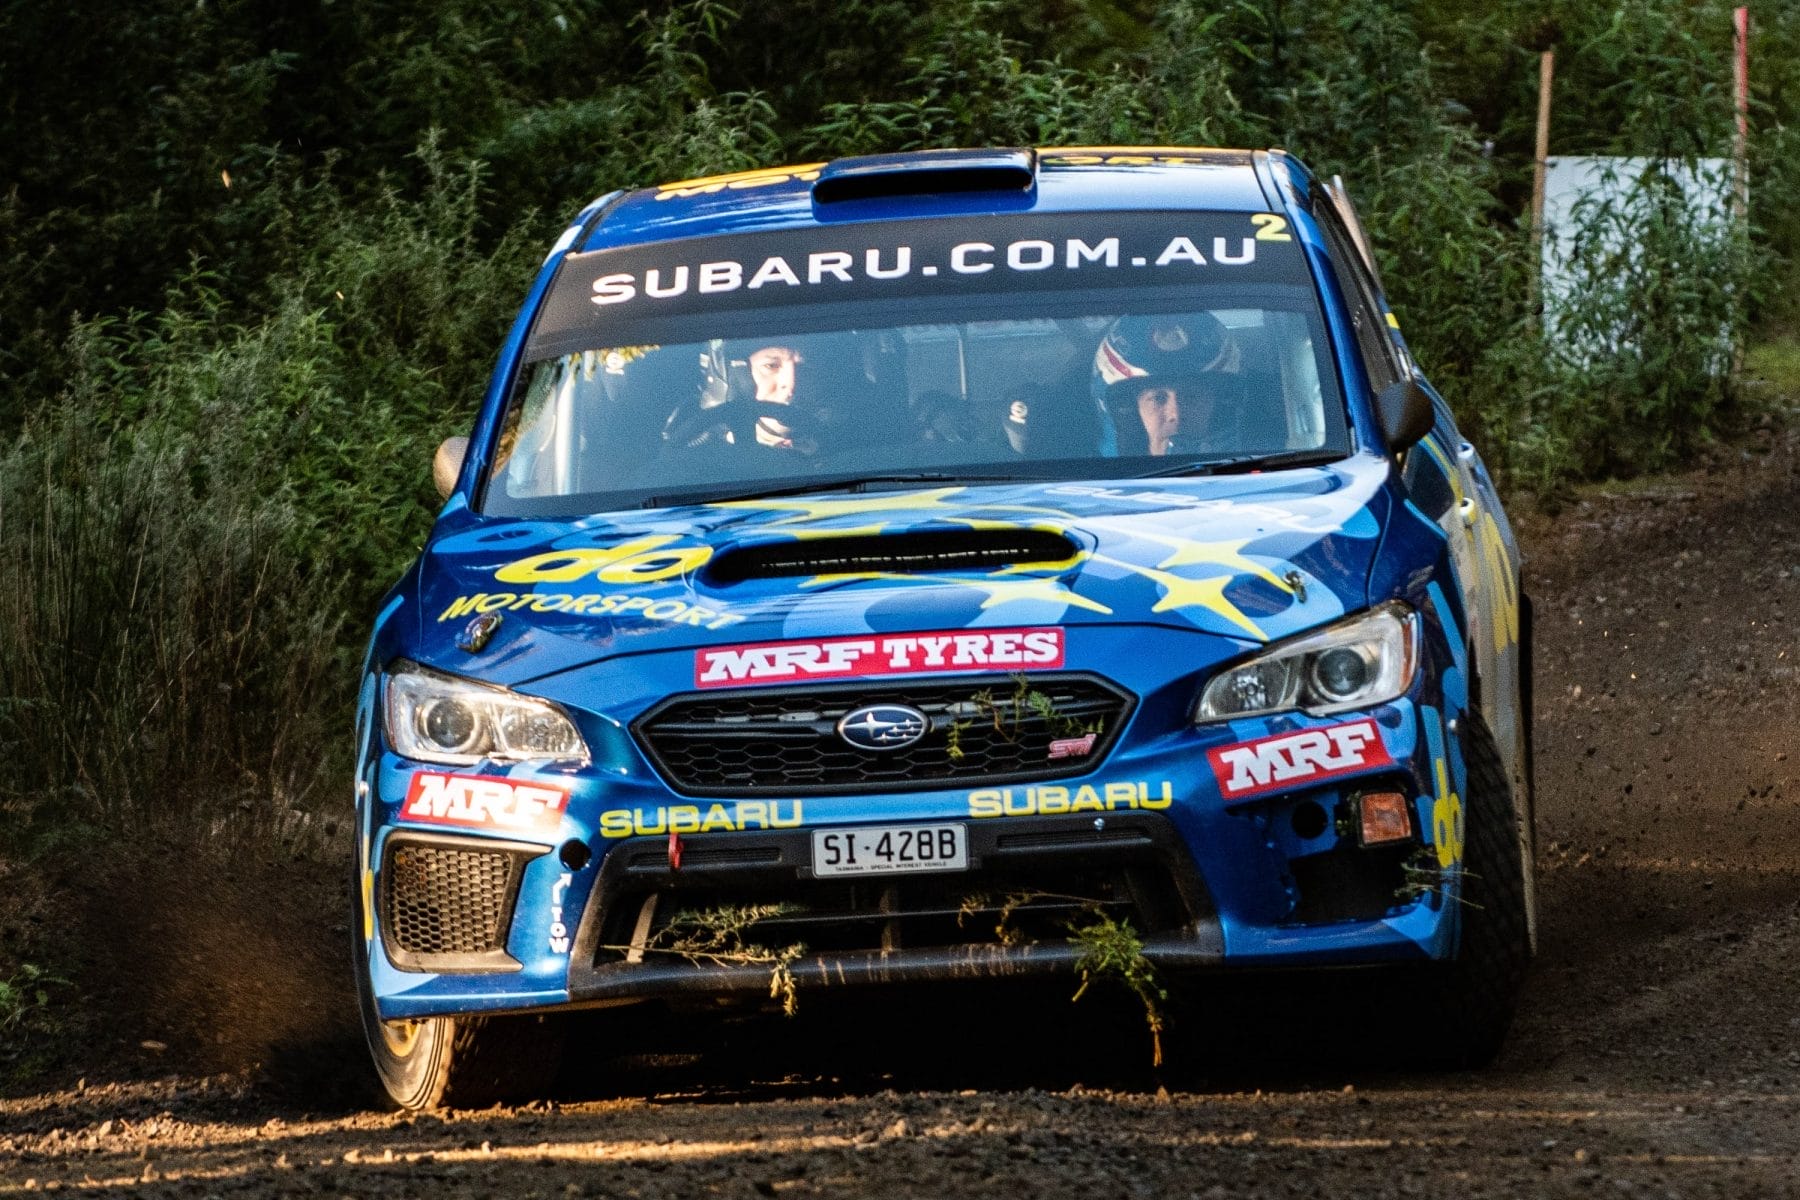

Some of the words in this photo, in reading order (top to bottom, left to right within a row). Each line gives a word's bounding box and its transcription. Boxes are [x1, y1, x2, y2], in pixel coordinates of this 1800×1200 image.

[1251, 213, 1291, 242] 2
[591, 236, 1256, 305] SUBARU.COM.AU
[437, 593, 747, 630] MOTORSPORT
[700, 639, 876, 682] MRF
[883, 632, 1059, 669] TYRES
[1219, 722, 1376, 792] MRF
[408, 774, 562, 827] MRF
[600, 800, 802, 838] SUBARU
[967, 781, 1172, 818] SUBARU
